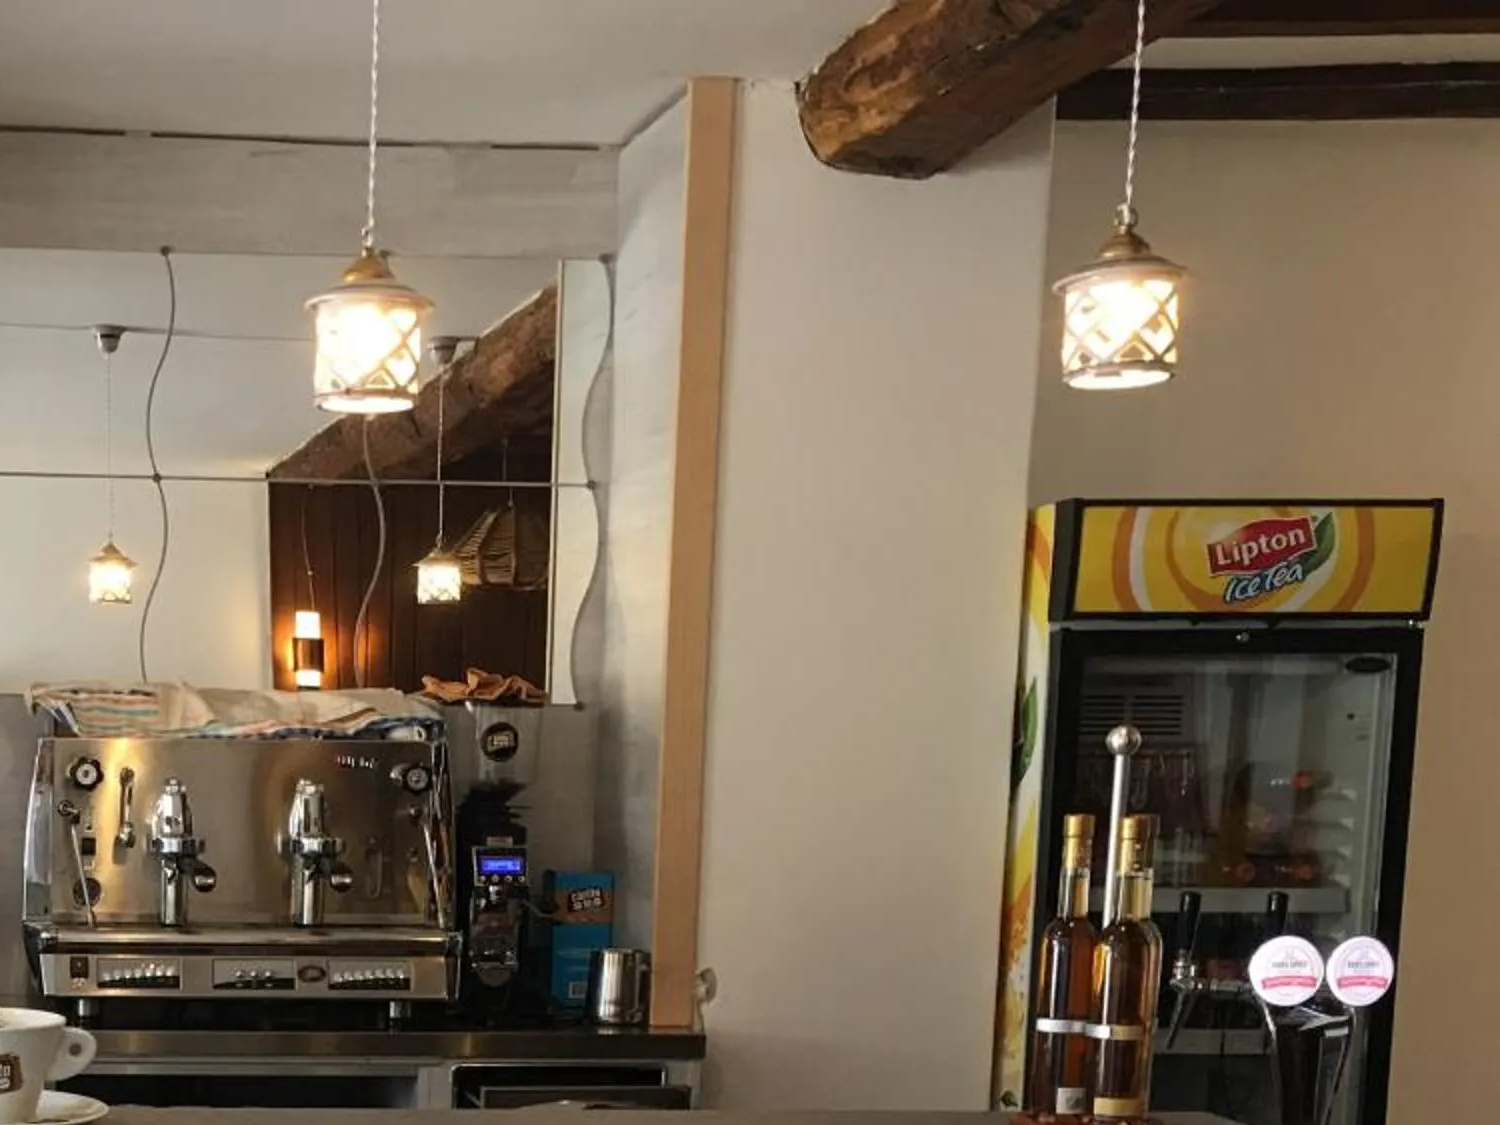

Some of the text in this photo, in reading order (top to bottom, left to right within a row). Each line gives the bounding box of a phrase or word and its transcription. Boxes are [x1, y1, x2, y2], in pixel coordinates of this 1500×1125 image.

[1215, 527, 1306, 566] Lipton
[1225, 561, 1304, 601] Ice Tea
